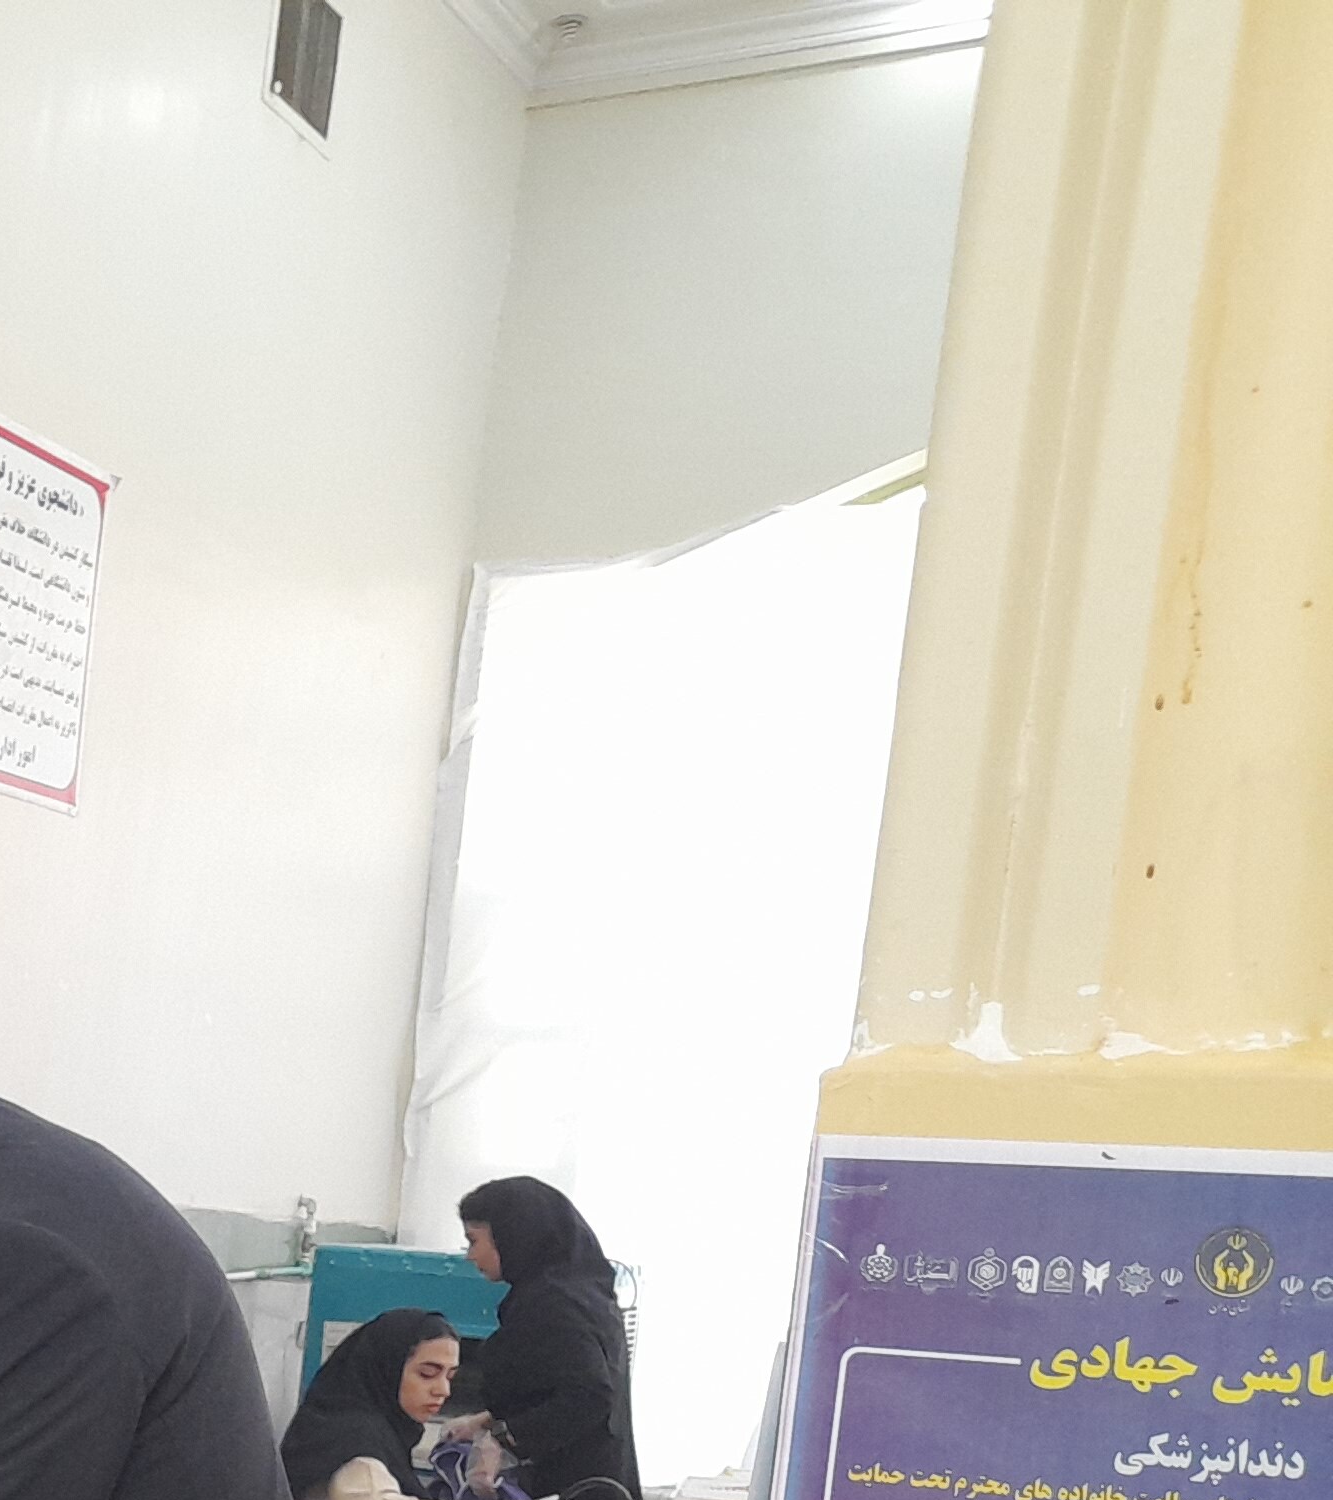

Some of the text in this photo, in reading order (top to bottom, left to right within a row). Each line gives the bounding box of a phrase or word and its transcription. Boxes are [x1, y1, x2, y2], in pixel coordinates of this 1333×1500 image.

[1030, 1336, 1333, 1406] ایش جهادی
[1114, 1433, 1304, 1484] دندانپزشکی
[848, 1463, 905, 1487] حمایت
[910, 1470, 951, 1489] تحت
[954, 1476, 1010, 1498] محترم
